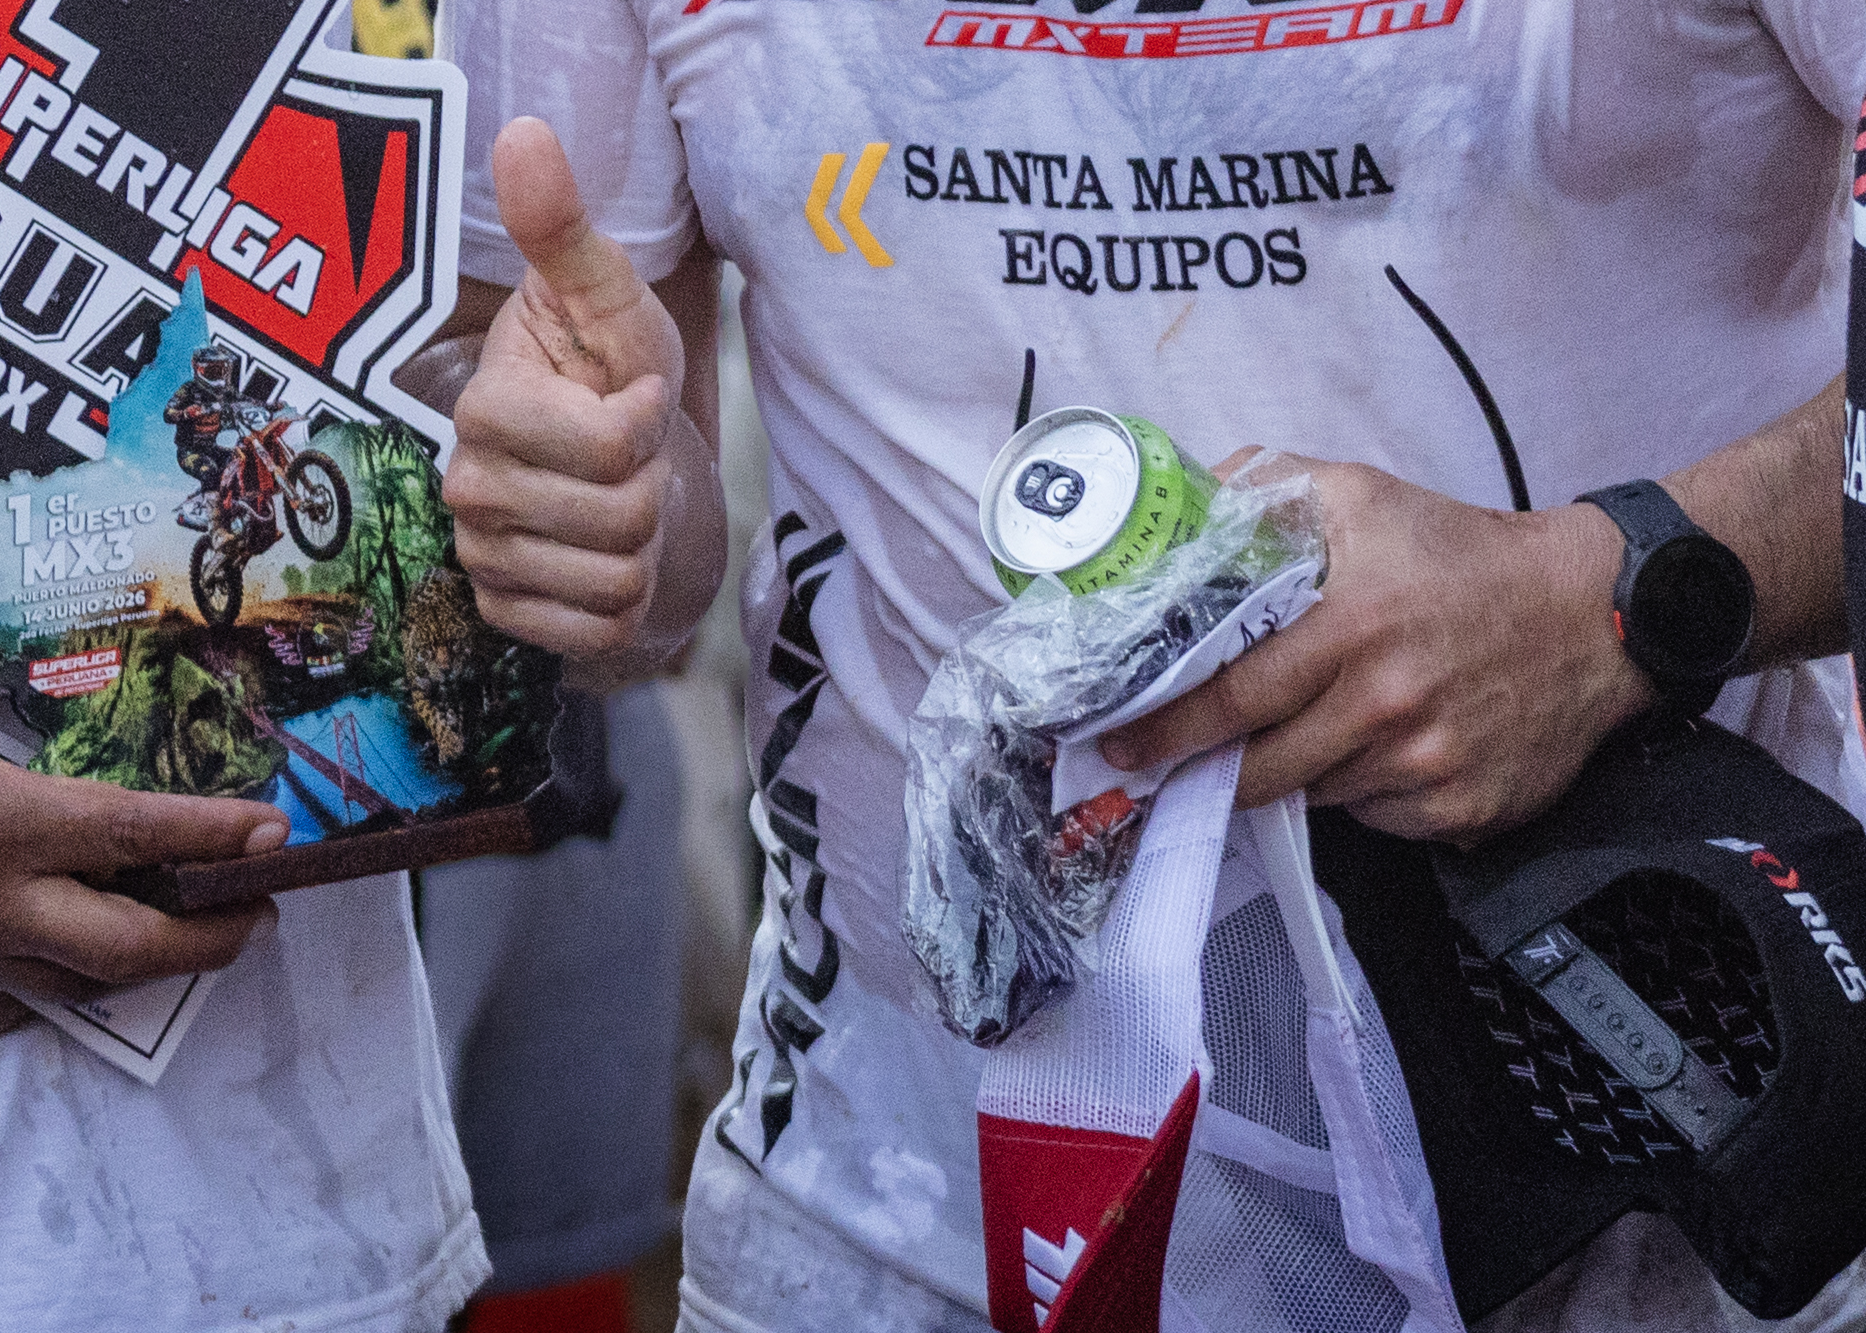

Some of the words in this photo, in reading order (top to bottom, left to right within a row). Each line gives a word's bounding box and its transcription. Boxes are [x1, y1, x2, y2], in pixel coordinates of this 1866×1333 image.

[903, 143, 1114, 212] SANTA
[1131, 142, 1394, 212] MARINA
[1000, 226, 1308, 297] EQUIPOS
[7, 493, 32, 546] 1
[47, 492, 79, 515] er
[47, 501, 157, 539] PUESTO
[23, 529, 135, 587] MX3
[13, 586, 65, 606] PUERTO
[68, 570, 157, 596] MALDONADO
[47, 598, 101, 621] JUNIO
[106, 589, 147, 610] 2026
